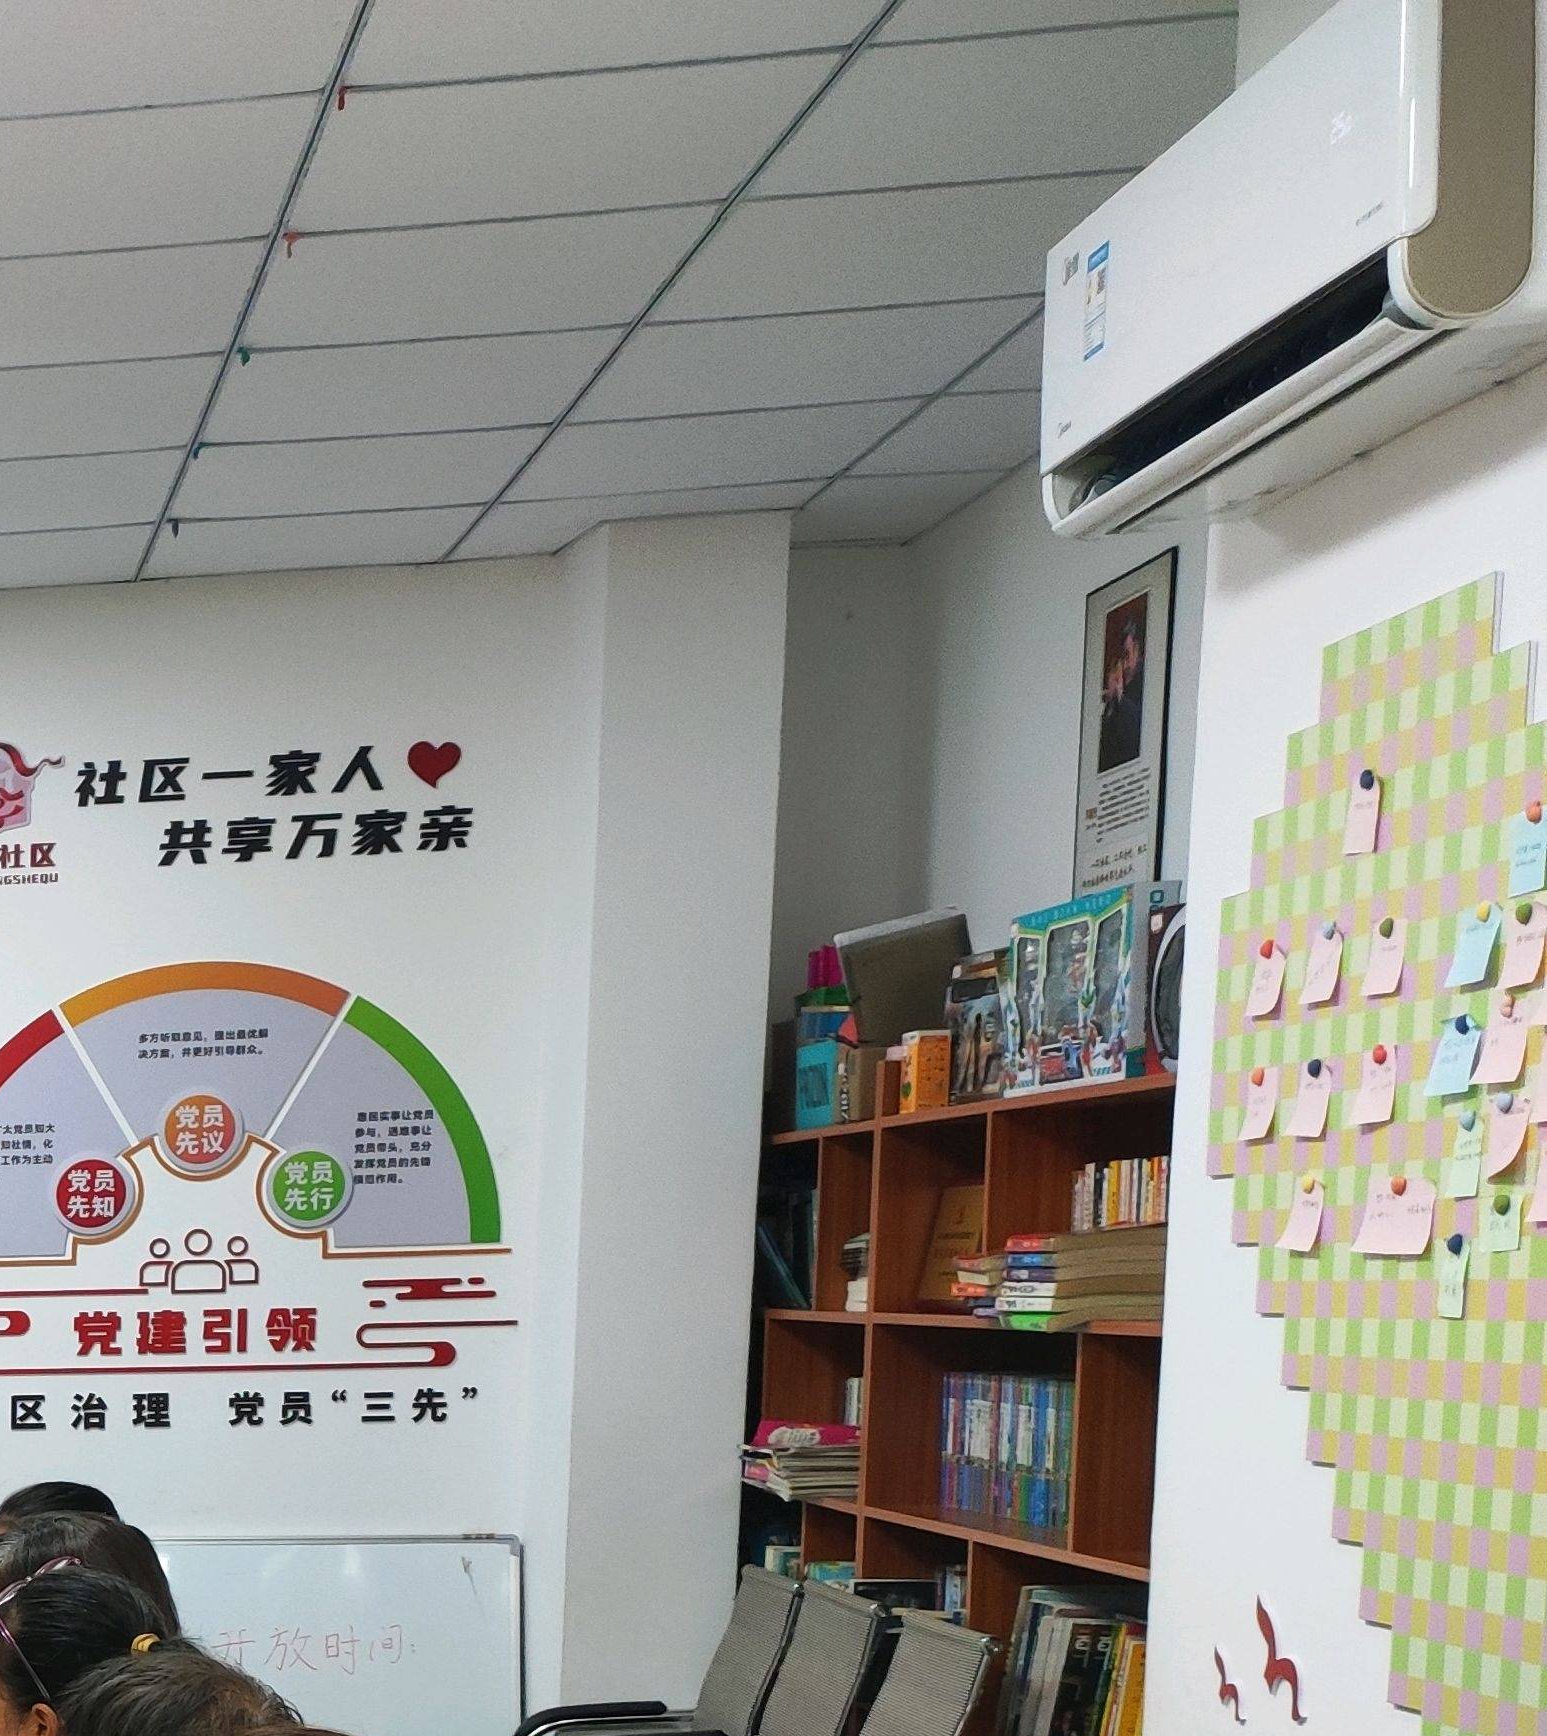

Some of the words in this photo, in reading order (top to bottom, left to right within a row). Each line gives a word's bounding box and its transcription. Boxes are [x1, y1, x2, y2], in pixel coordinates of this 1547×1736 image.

[74, 745, 384, 808] 社区一家人
[158, 805, 475, 868] 共享万家亲
[175, 1104, 225, 1129] 党员
[175, 1130, 225, 1155] 先议
[67, 1168, 116, 1193] 党员
[284, 1160, 334, 1185] 党员
[67, 1194, 116, 1219] 先知
[284, 1187, 334, 1212] 先行
[73, 1306, 319, 1357] 党建引领
[228, 1387, 479, 1428] 党员“三先”
